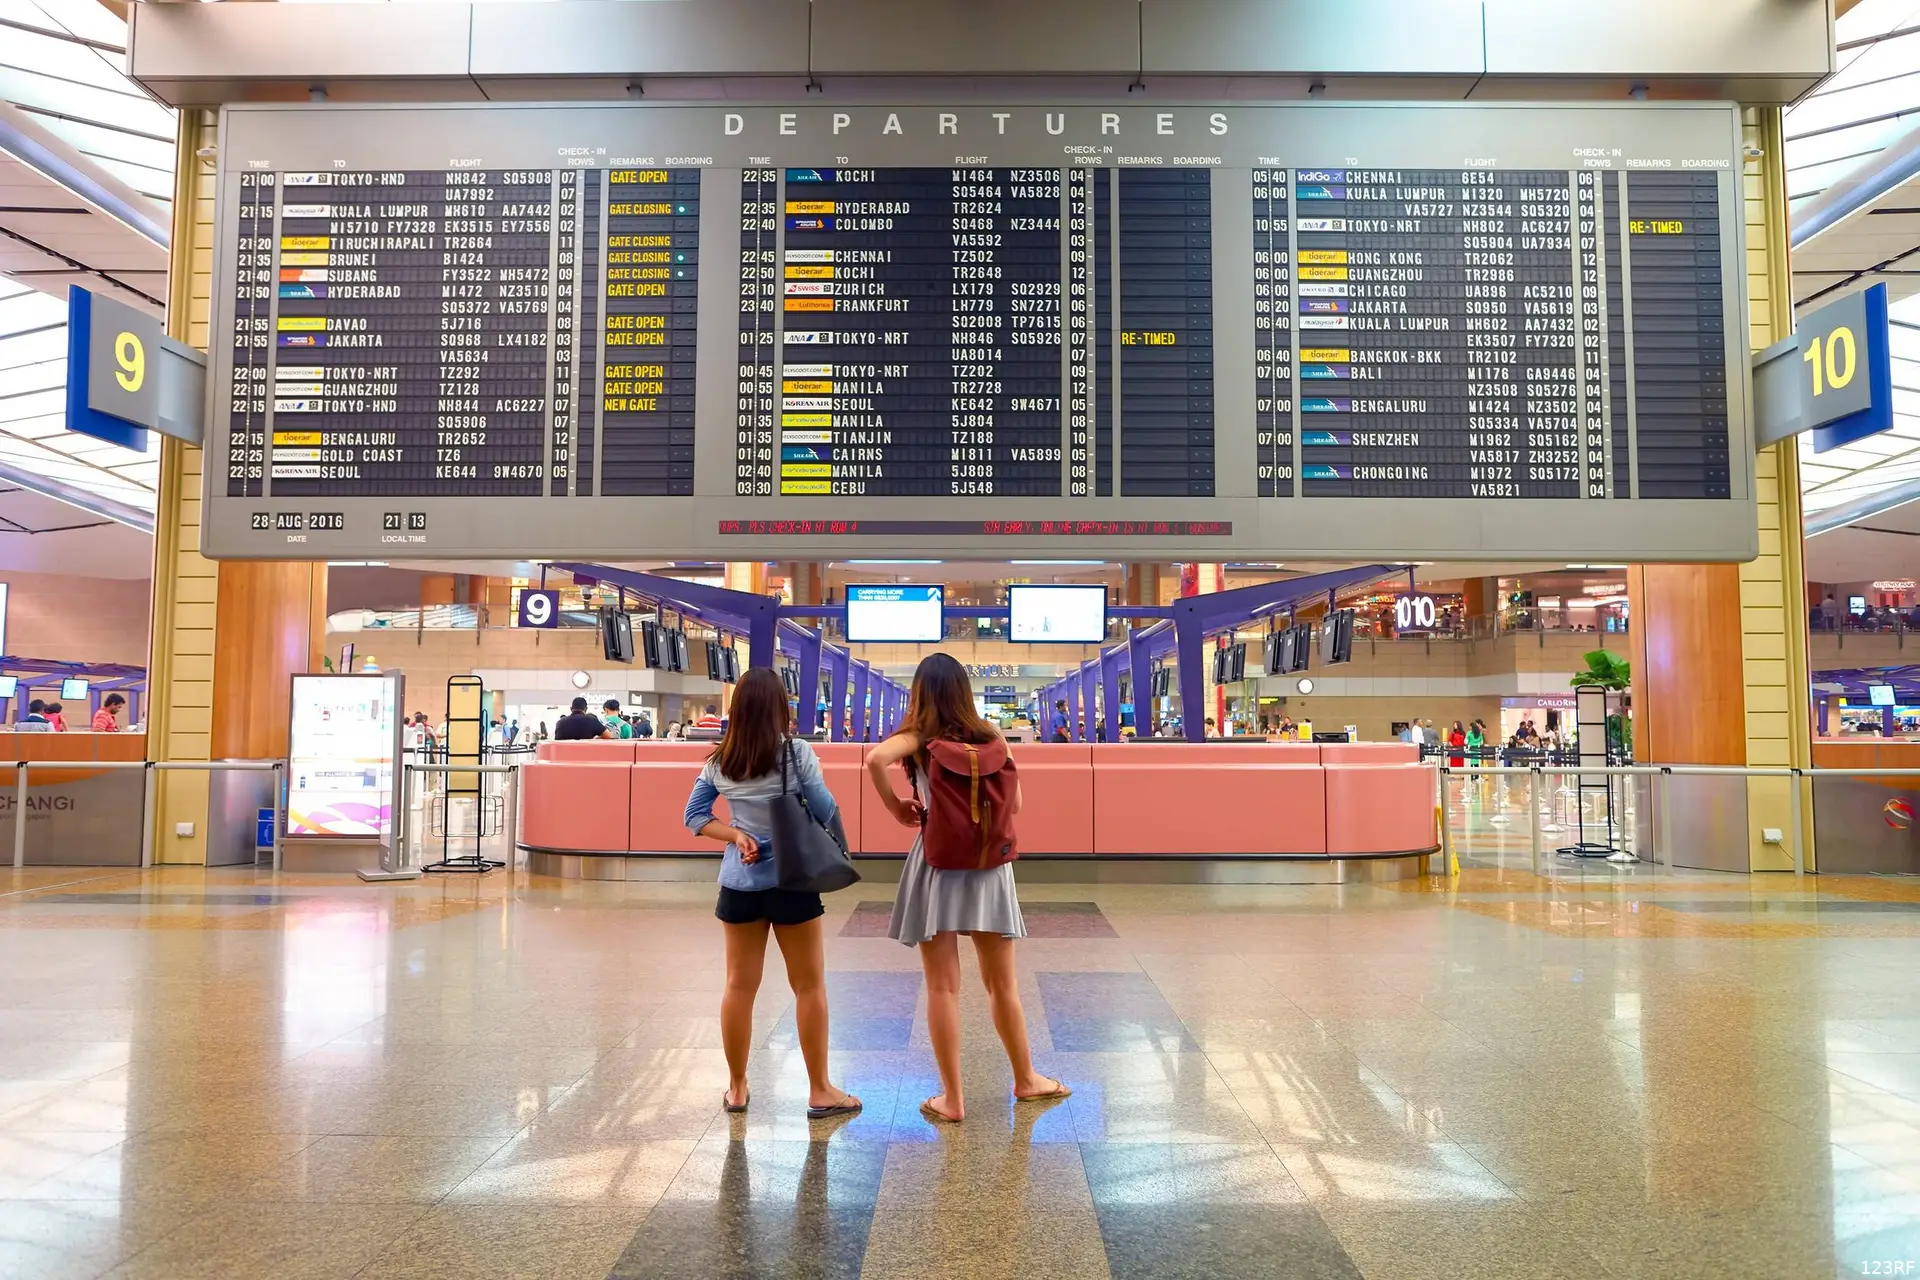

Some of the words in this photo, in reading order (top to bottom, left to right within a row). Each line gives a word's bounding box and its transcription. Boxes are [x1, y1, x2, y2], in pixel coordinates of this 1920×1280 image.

[724, 113, 1228, 135] DEPARTURES
[1064, 146, 1095, 154] CHECK
[1573, 148, 1604, 156] CHECK
[450, 159, 482, 167] FLIGHT
[568, 158, 595, 166] ROWS
[665, 157, 712, 165] BOARDING
[749, 157, 770, 165] TIME
[1075, 156, 1102, 164] ROWS
[1173, 157, 1221, 165] BOARDING
[1258, 157, 1280, 165] TIME
[1464, 158, 1497, 166] FLIGHT
[1584, 159, 1611, 167] ROWS
[1626, 159, 1671, 167] REMARKS
[1682, 159, 1729, 168] BOARDING
[332, 174, 405, 185] TOKYO-HND
[446, 173, 487, 184] NH842
[503, 172, 551, 184] SQ5908
[611, 171, 636, 183] GATE
[640, 171, 668, 183] OPEN
[836, 171, 876, 181] KOCHI
[952, 170, 994, 181] MI464
[1010, 171, 1060, 181] NZ3506
[1298, 172, 1330, 182] IndiGo
[1346, 172, 1402, 183] CHENNAI
[1461, 172, 1494, 184] 6E54
[1347, 188, 1388, 199] KUALA
[1396, 188, 1445, 199] LUMPUR
[331, 206, 371, 217] KUALA
[379, 205, 428, 217] LUMPUR
[445, 205, 485, 216] MH610
[502, 205, 550, 216] AA7442
[610, 204, 630, 215] GATE
[631, 204, 671, 215] CLOSING
[835, 203, 910, 214] HYDERABAD
[1405, 204, 1454, 216] VA5727
[330, 222, 379, 233] MI5710
[387, 221, 436, 233] FY7328
[835, 219, 893, 230] COLOMBO
[1347, 220, 1421, 232] TOKYO-NRT
[1463, 221, 1504, 232] NH802
[1521, 221, 1571, 233] AC6247
[1630, 221, 1683, 234] RE-TIMED
[329, 238, 433, 249] TIRUCHIRAPALI
[609, 236, 630, 247] GATE
[632, 236, 671, 247] CLOSING
[329, 254, 376, 265] BRUNEI
[835, 251, 891, 262] CHENNAI
[1348, 253, 1381, 264] HONG
[1389, 253, 1422, 264] KONG
[328, 270, 377, 281] SUBANG
[835, 267, 875, 278] KOCHI
[1349, 269, 1423, 280] GUANGZHOU
[328, 286, 401, 298] HYDERABAD
[608, 284, 634, 296] GATE
[636, 284, 665, 296] OPEN
[834, 284, 884, 295] ZURICH
[952, 283, 993, 294] LX179
[1010, 283, 1060, 295] SQ2929
[1349, 285, 1407, 297] CHICAGO
[1465, 286, 1506, 297] UA896
[1523, 286, 1573, 298] AC5210
[834, 300, 909, 311] FRANKFURT
[1349, 302, 1407, 313] JAKARTA
[326, 319, 367, 330] DAVAO
[607, 317, 633, 329] GATE
[636, 317, 665, 329] OPEN
[1350, 318, 1391, 329] KUALA
[1399, 318, 1449, 330] LUMPUR
[326, 335, 383, 346] JAKARTA
[834, 333, 909, 344] TOKYO-NRT
[952, 333, 993, 344] NH846
[1010, 333, 1060, 344] SQ5926
[1122, 332, 1175, 345] RE-TIMED
[115, 331, 145, 393] 9
[1351, 351, 1441, 362] BANGKOK-BKK
[1467, 351, 1516, 363] TR2102
[1803, 326, 1856, 397] 10
[324, 368, 397, 379] TOKYO-NRT
[834, 366, 908, 377] TOKYO-NRT
[1351, 367, 1382, 379] BALI
[324, 384, 397, 395] GUANGZHOU
[833, 382, 883, 393] MANILA
[323, 400, 396, 412] TOKYO-HND
[438, 400, 479, 411] NH844
[496, 400, 544, 411] AC6227
[605, 398, 627, 411] NEW
[629, 398, 656, 411] GATE
[833, 399, 875, 410] SEOUL
[1352, 400, 1426, 412] BENGALURU
[833, 415, 883, 427] MANILA
[322, 433, 395, 445] BENGALURU
[833, 432, 891, 443] TIANJIN
[1353, 434, 1418, 445] SHENZHEN
[321, 450, 354, 461] GOLD
[362, 450, 402, 461] COAST
[833, 449, 882, 460] CAIRNS
[951, 449, 991, 460] MI811
[1011, 449, 1060, 460] VA5899
[321, 466, 361, 478] SEOUL
[436, 466, 476, 477] KE644
[494, 466, 542, 477] 9W4670
[832, 465, 882, 477] MANILA
[1353, 467, 1427, 479] CHONGQING
[1470, 467, 1512, 479] MI972
[1529, 468, 1579, 479] SQ5172
[832, 482, 865, 494] CEBU
[951, 482, 992, 493] 5J548
[287, 535, 307, 543] DATE
[381, 535, 407, 543] LOCAL
[408, 535, 426, 543] TIME
[526, 593, 551, 625] 9
[1411, 596, 1436, 628] 10
